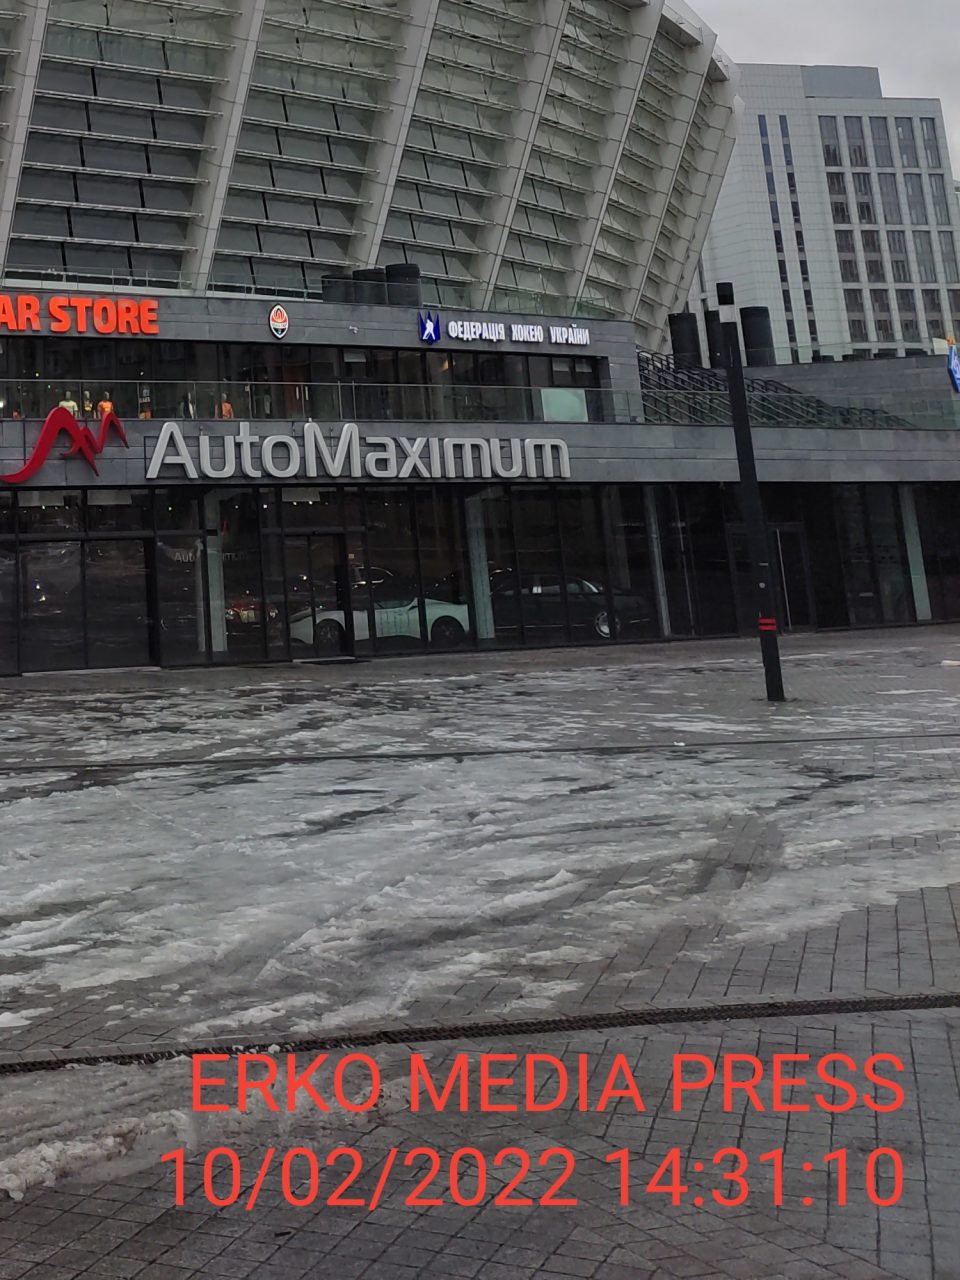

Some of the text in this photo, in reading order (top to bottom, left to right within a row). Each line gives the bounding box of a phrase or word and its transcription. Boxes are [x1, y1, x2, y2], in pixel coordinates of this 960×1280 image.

[49, 296, 160, 334] STORE
[447, 320, 590, 345] ФЕДЕРАЦІЯ ХОКЕЮ УКРАЇНИ
[145, 421, 571, 479] AutoMaximum
